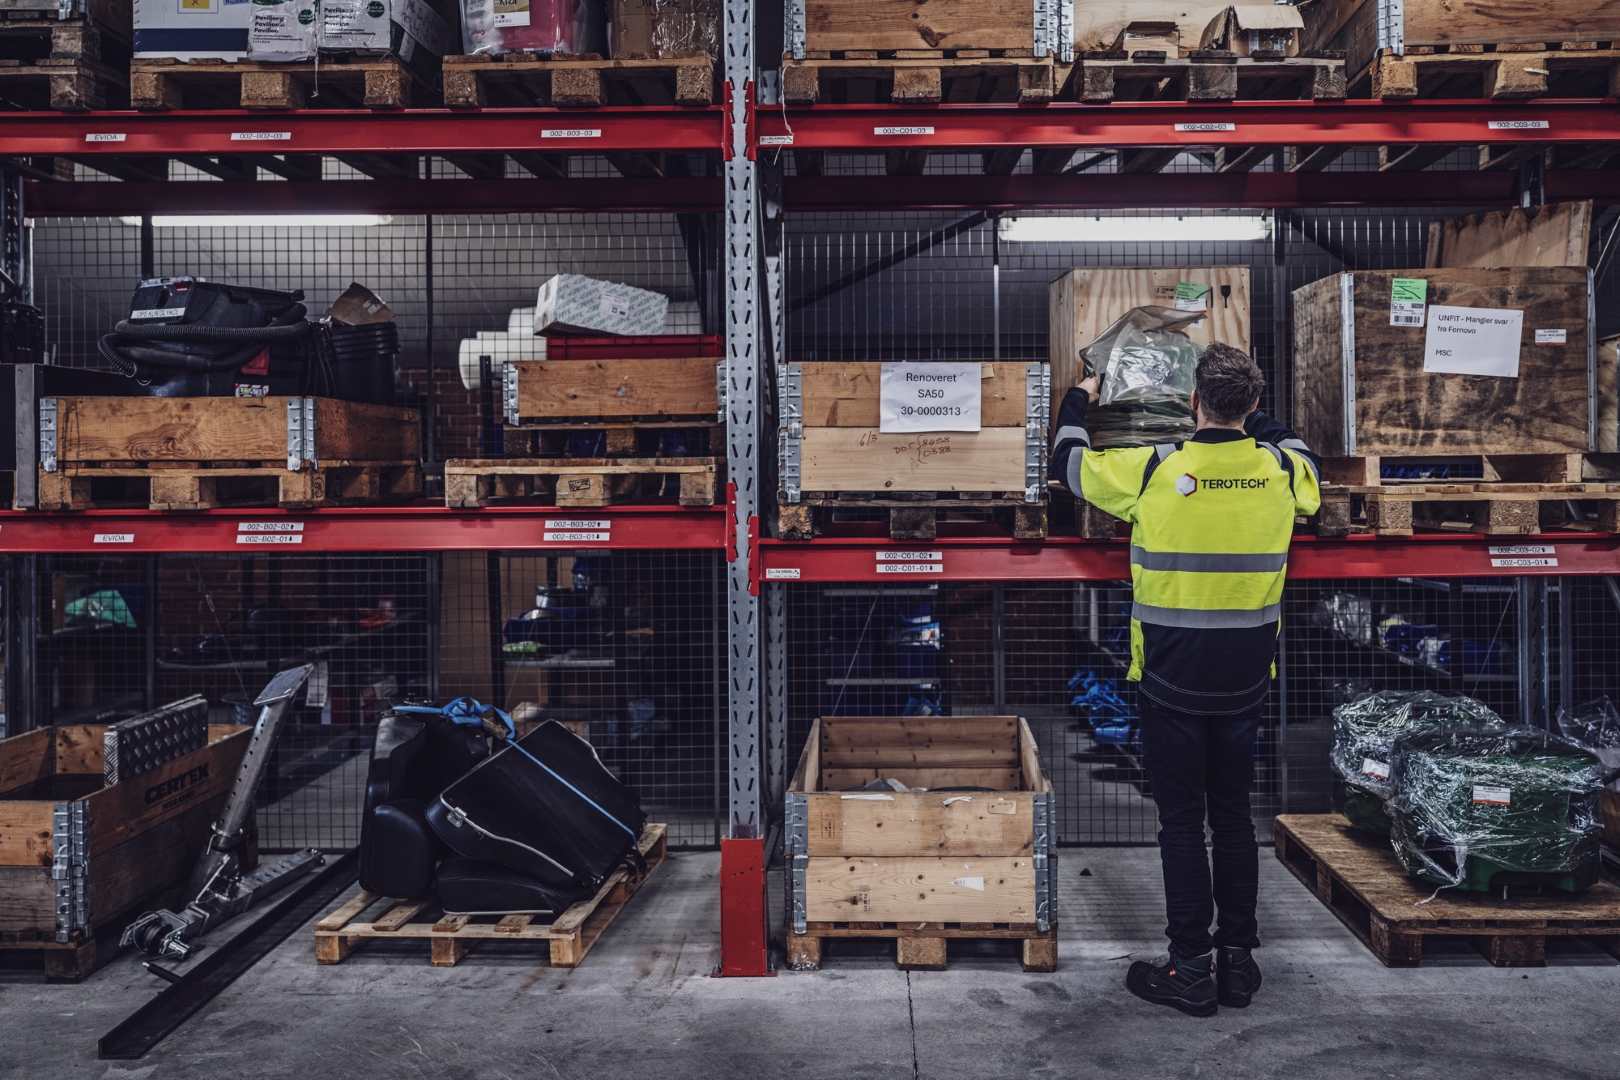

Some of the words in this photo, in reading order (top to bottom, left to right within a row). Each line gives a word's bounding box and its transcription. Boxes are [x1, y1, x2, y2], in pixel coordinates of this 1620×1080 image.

[1438, 314, 1461, 322] UNFIT
[906, 372, 957, 382] Renoveret
[918, 389, 944, 399] SA50
[900, 406, 961, 416] 30-0000313
